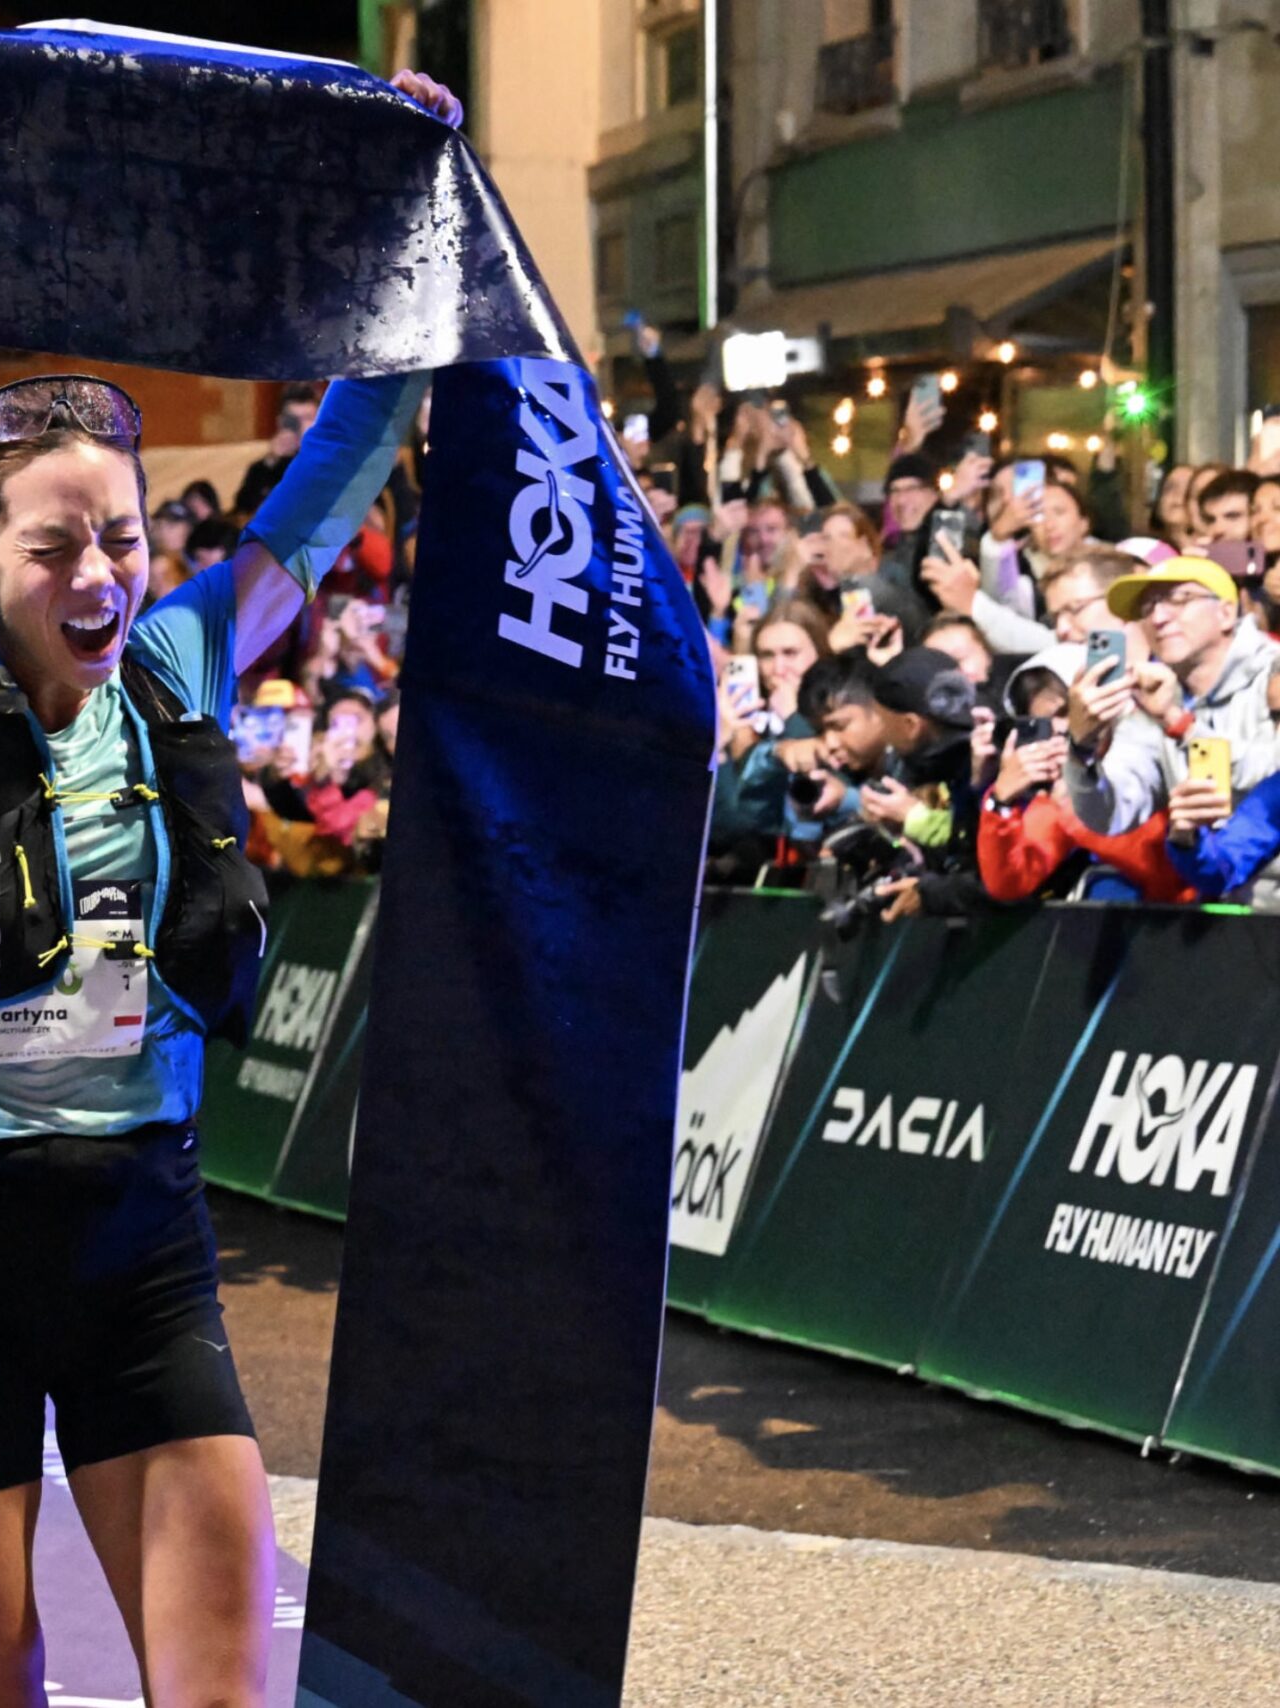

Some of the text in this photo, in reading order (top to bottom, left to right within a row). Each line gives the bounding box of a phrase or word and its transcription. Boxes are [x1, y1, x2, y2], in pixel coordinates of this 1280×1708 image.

[498, 358, 597, 668] HOKA
[604, 609, 640, 680] FLY
[822, 1086, 985, 1163] DACIA
[1069, 1050, 1259, 1197] HOKA
[1044, 1203, 1218, 1280] FLY HUMAN FLY
